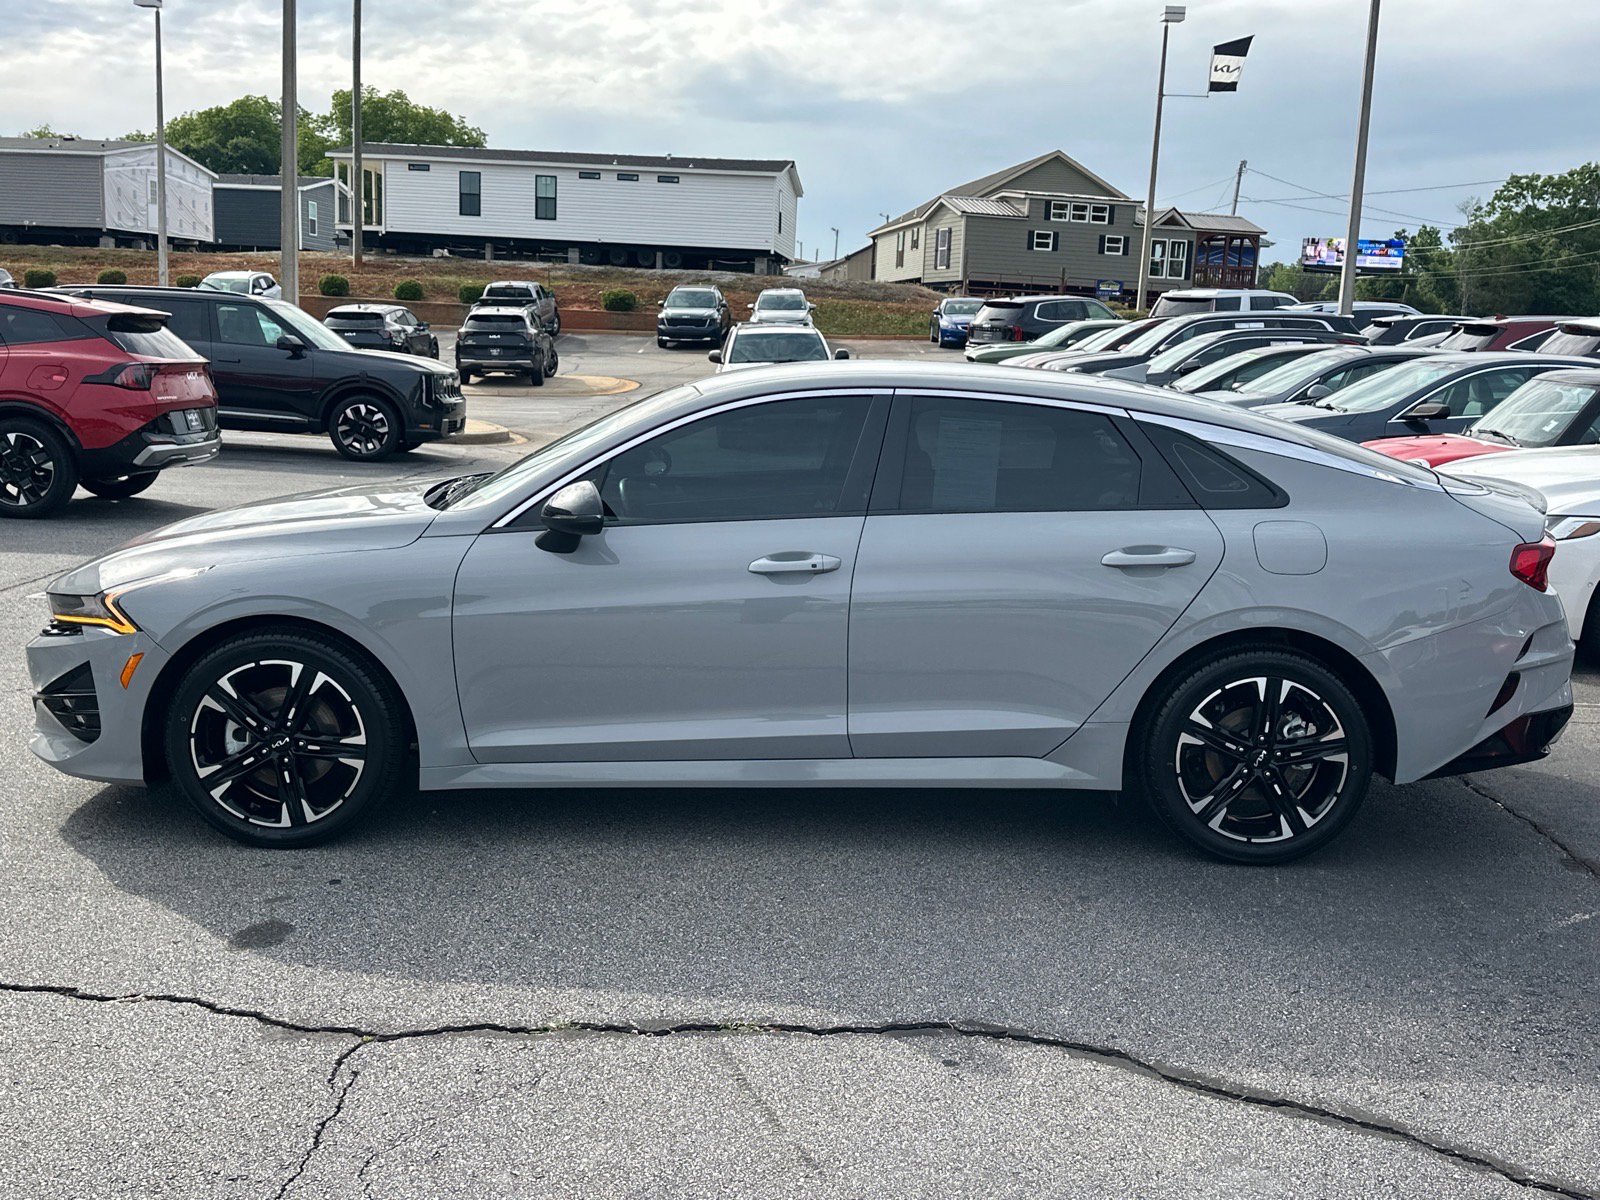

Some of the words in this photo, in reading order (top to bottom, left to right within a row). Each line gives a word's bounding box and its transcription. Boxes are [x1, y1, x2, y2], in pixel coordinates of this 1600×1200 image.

[1213, 64, 1241, 74] KIA
[271, 736, 290, 749] KIA
[1253, 749, 1267, 767] KIA
